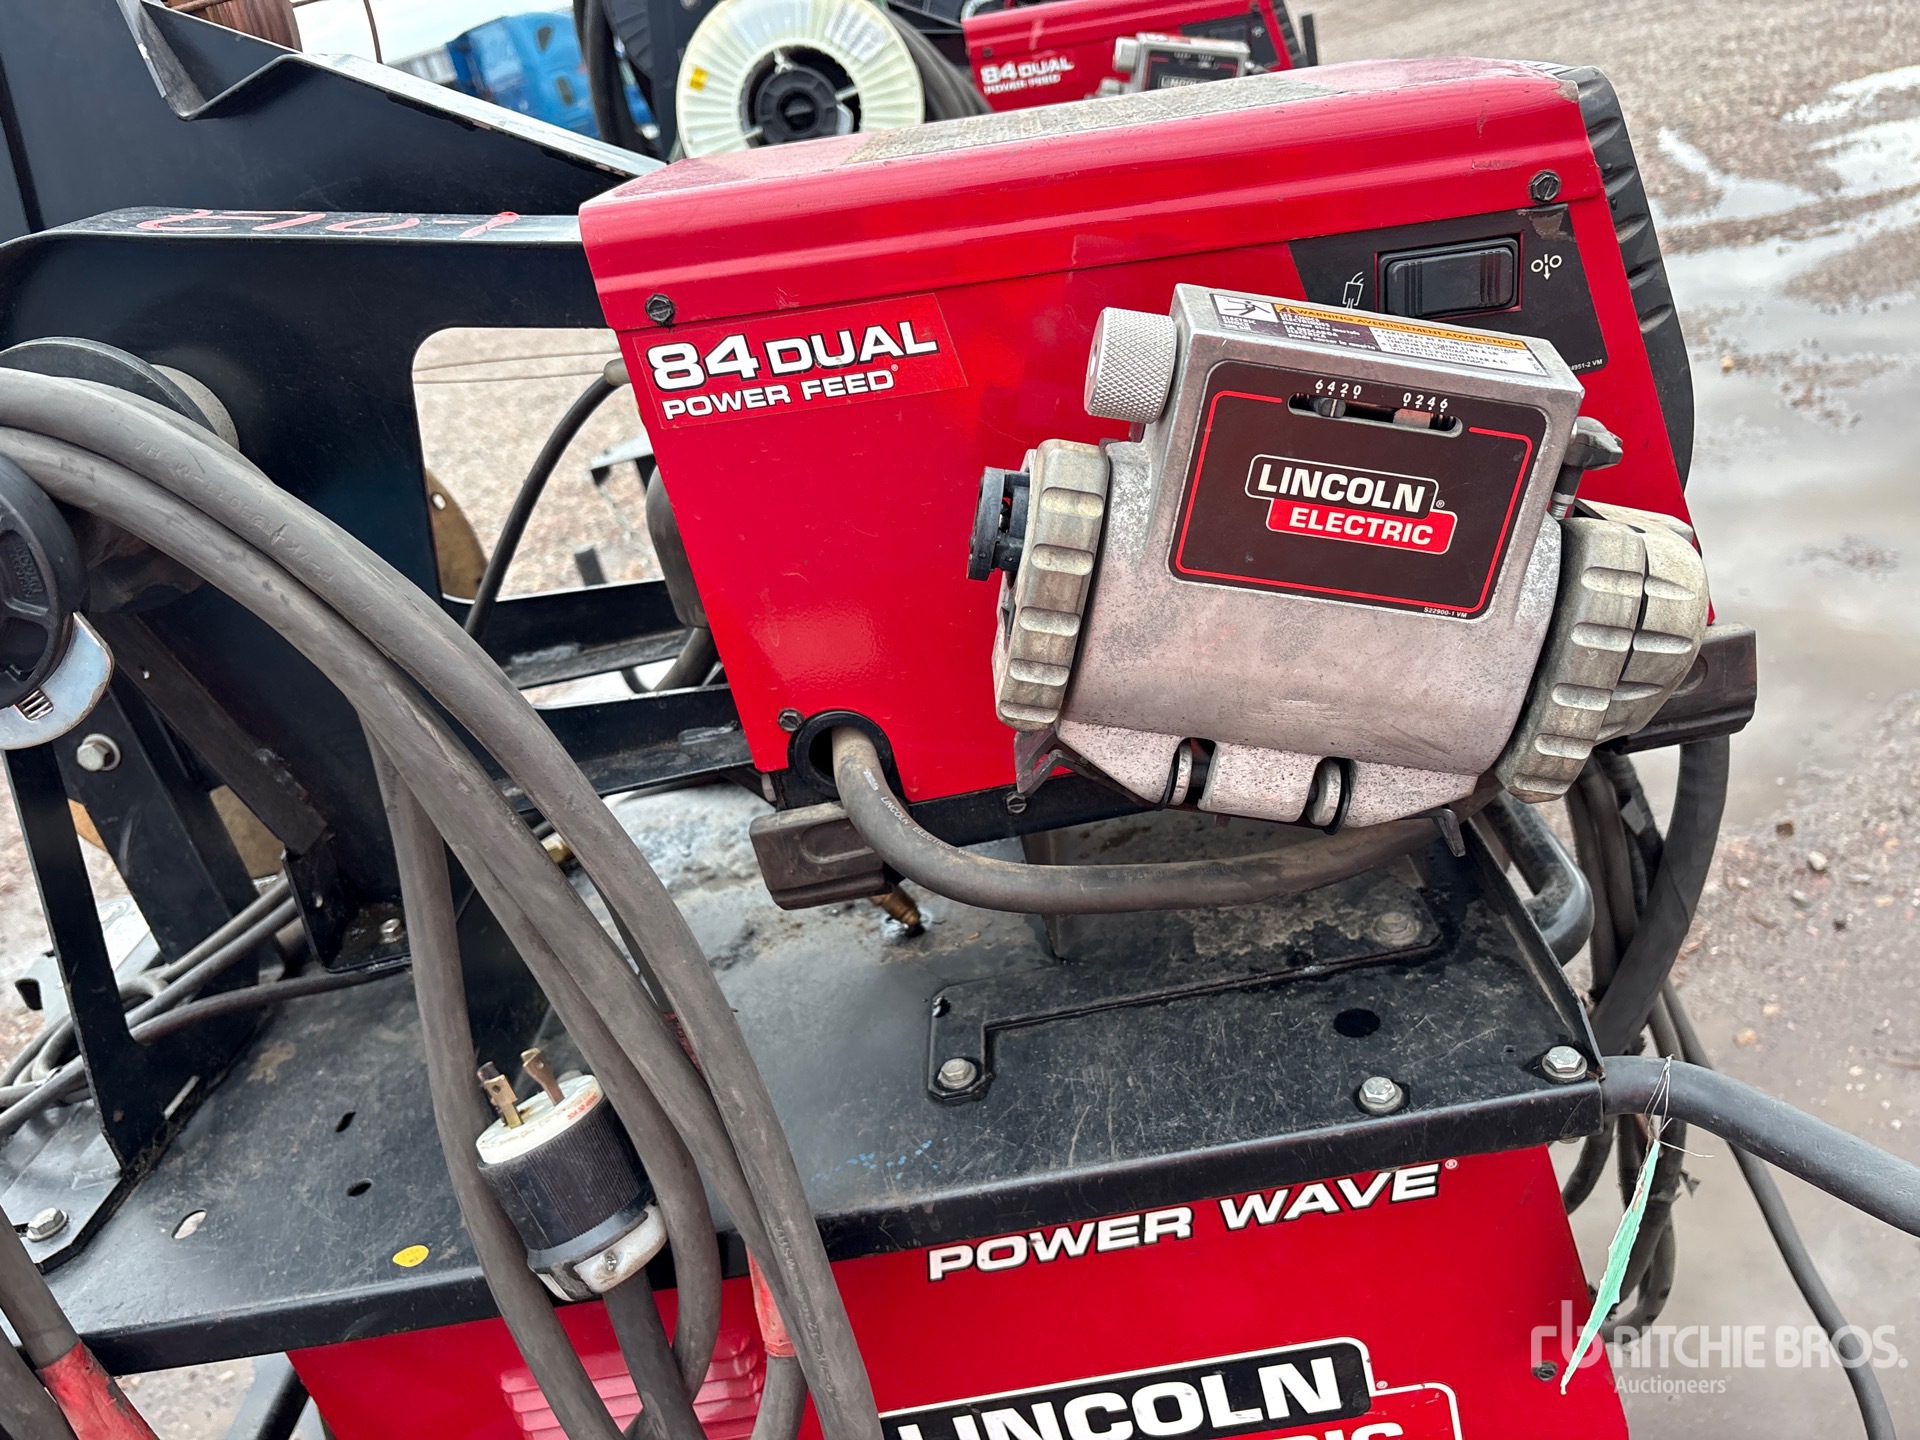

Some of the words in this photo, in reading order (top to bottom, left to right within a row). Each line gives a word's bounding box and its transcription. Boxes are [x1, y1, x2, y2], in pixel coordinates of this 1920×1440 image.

[981, 61, 1018, 85] 84
[1018, 56, 1075, 78] DUAL
[1299, 309, 1354, 321] WARNING
[1357, 319, 1442, 335] AVERTISSEMENT
[648, 334, 760, 391] 84
[765, 320, 940, 376] DUAL
[1592, 358, 1603, 366] VM
[662, 384, 792, 420] POWER
[801, 369, 894, 400] FEED
[1258, 464, 1425, 513] LINCOLN
[1289, 507, 1434, 545] ELECTRIC
[1423, 606, 1455, 616] S22900-1
[880, 796, 911, 825] LINCOLN
[912, 826, 951, 850] ELECTRIC
[928, 1205, 1194, 1282] POWER
[1218, 1163, 1440, 1231] WAVE
